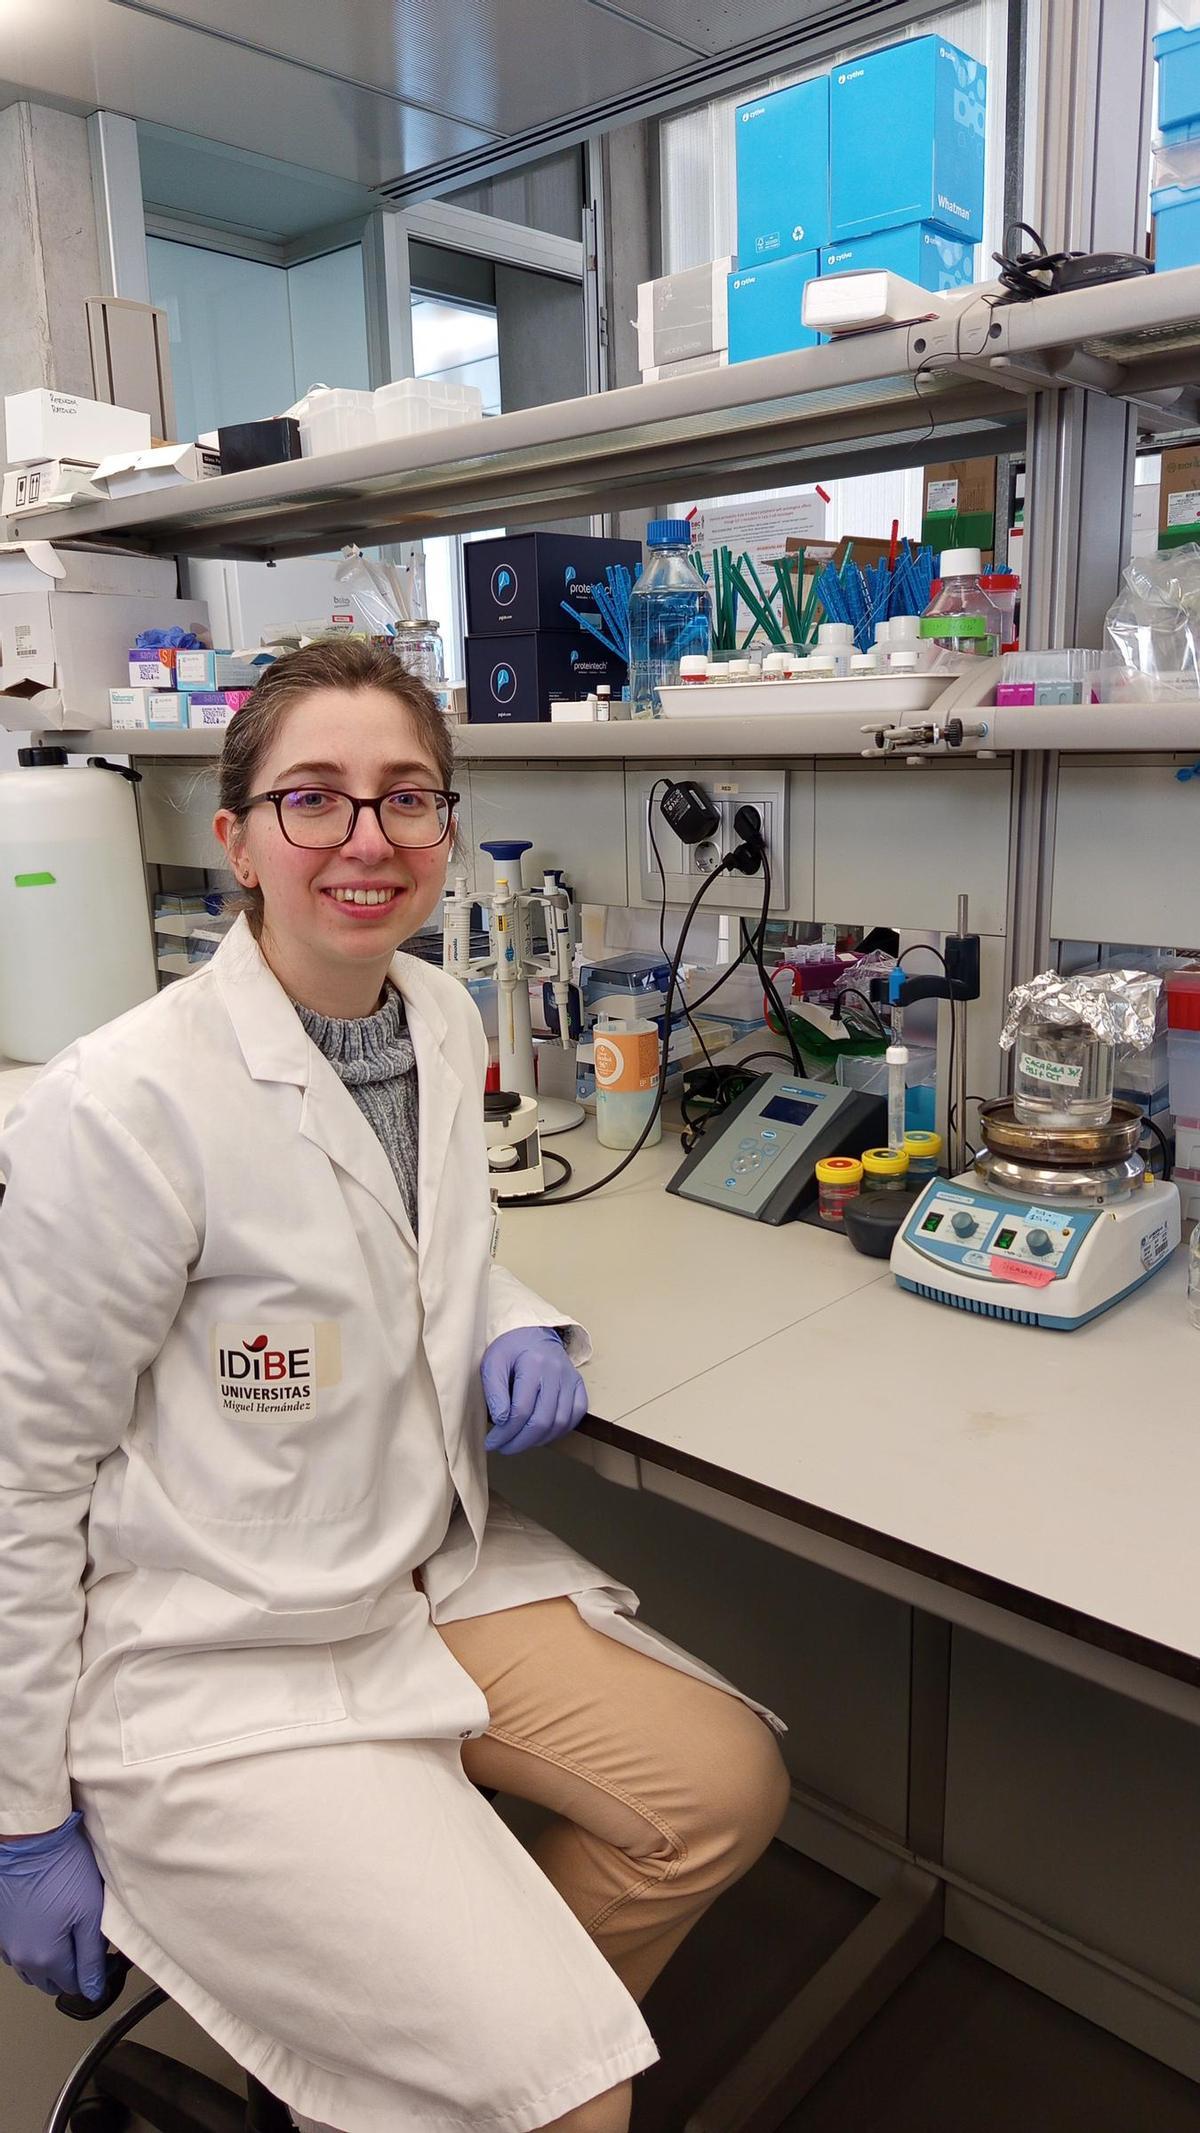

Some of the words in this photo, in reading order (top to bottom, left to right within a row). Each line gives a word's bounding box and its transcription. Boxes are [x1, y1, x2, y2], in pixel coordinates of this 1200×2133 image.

[937, 194, 970, 221] Whatman
[573, 662, 607, 671] proteintech
[221, 1384, 311, 1400] UNIVERSITAS
[222, 1399, 254, 1413] Miguel
[256, 1401, 311, 1413] Hernández
